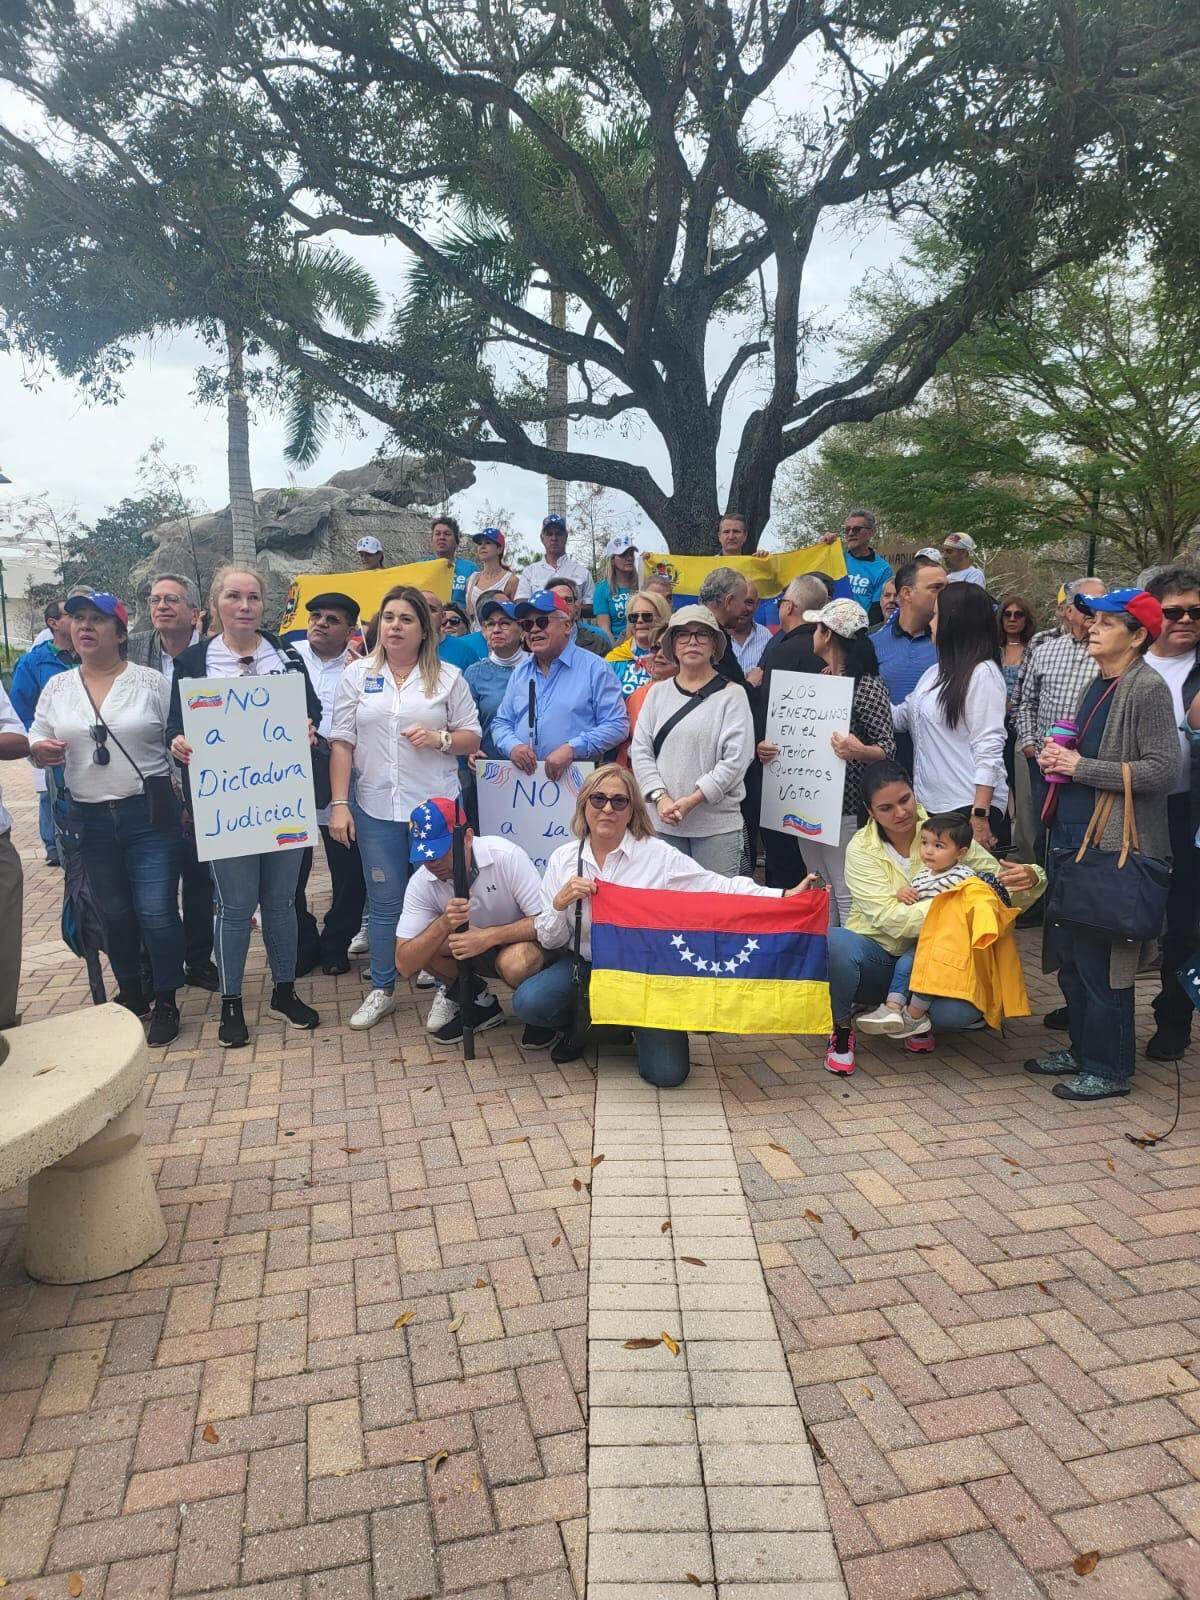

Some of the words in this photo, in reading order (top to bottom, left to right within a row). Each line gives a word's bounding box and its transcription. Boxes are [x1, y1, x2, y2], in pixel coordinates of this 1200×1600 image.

[225, 687, 270, 715] NO
[780, 685, 816, 701] LOS
[206, 729, 226, 745] a
[263, 718, 293, 743] la
[780, 725, 797, 736] EN
[769, 760, 832, 781] Queremos
[512, 779, 560, 809] NO
[205, 797, 306, 837] Judicial
[500, 821, 517, 835] a
